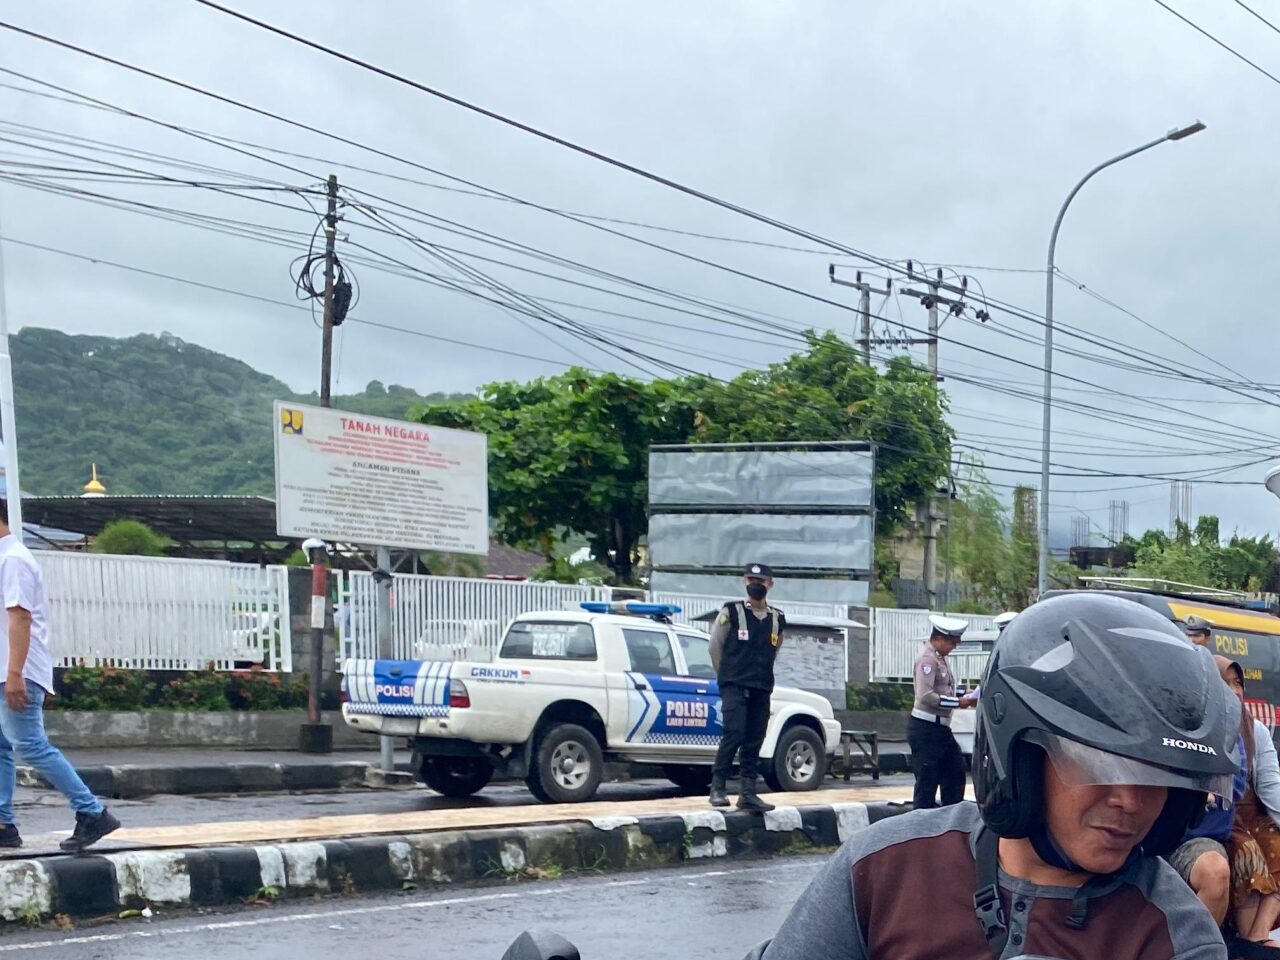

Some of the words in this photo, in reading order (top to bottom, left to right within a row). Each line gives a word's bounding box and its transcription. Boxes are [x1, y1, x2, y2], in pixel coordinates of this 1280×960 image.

[340, 418, 381, 435] TANAH
[384, 425, 430, 442] NEGARA
[1215, 634, 1248, 655] POLISI
[470, 667, 519, 679] GAKKUM
[1244, 668, 1263, 681] LUHAN
[376, 684, 414, 698] POLISI
[666, 700, 708, 718] POLISI
[1161, 736, 1217, 756] HONDA
